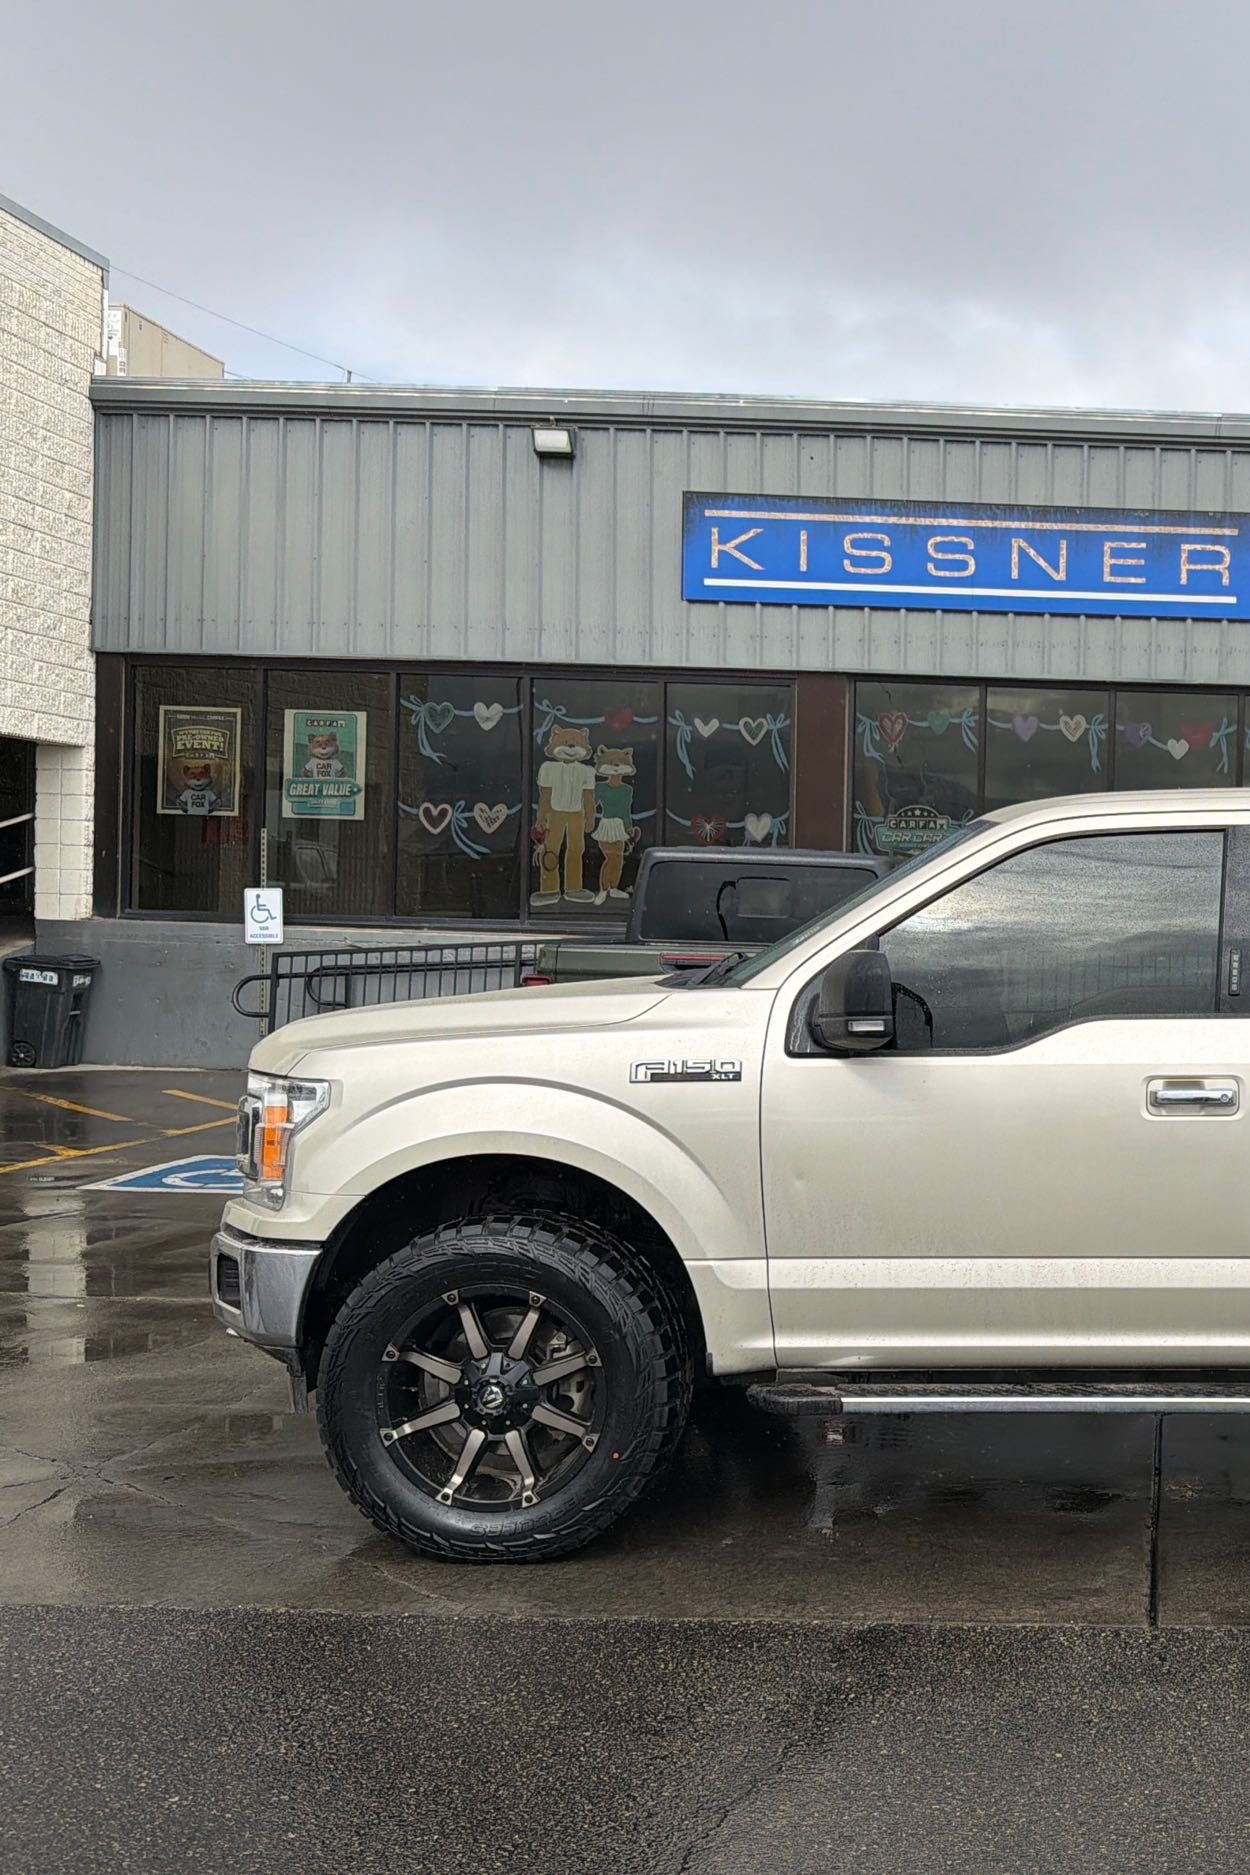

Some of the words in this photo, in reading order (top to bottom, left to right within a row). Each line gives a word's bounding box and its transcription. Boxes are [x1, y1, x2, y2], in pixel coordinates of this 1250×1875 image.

[711, 527, 1231, 588] KISSNER
[176, 734, 225, 742] PRE-OWNED
[176, 740, 224, 751] EVENT!
[289, 783, 320, 796] GREAT
[322, 783, 352, 796] VALUE
[889, 819, 947, 830] CARFAX
[881, 833, 910, 842] CAR
[711, 1072, 736, 1080] XLT
